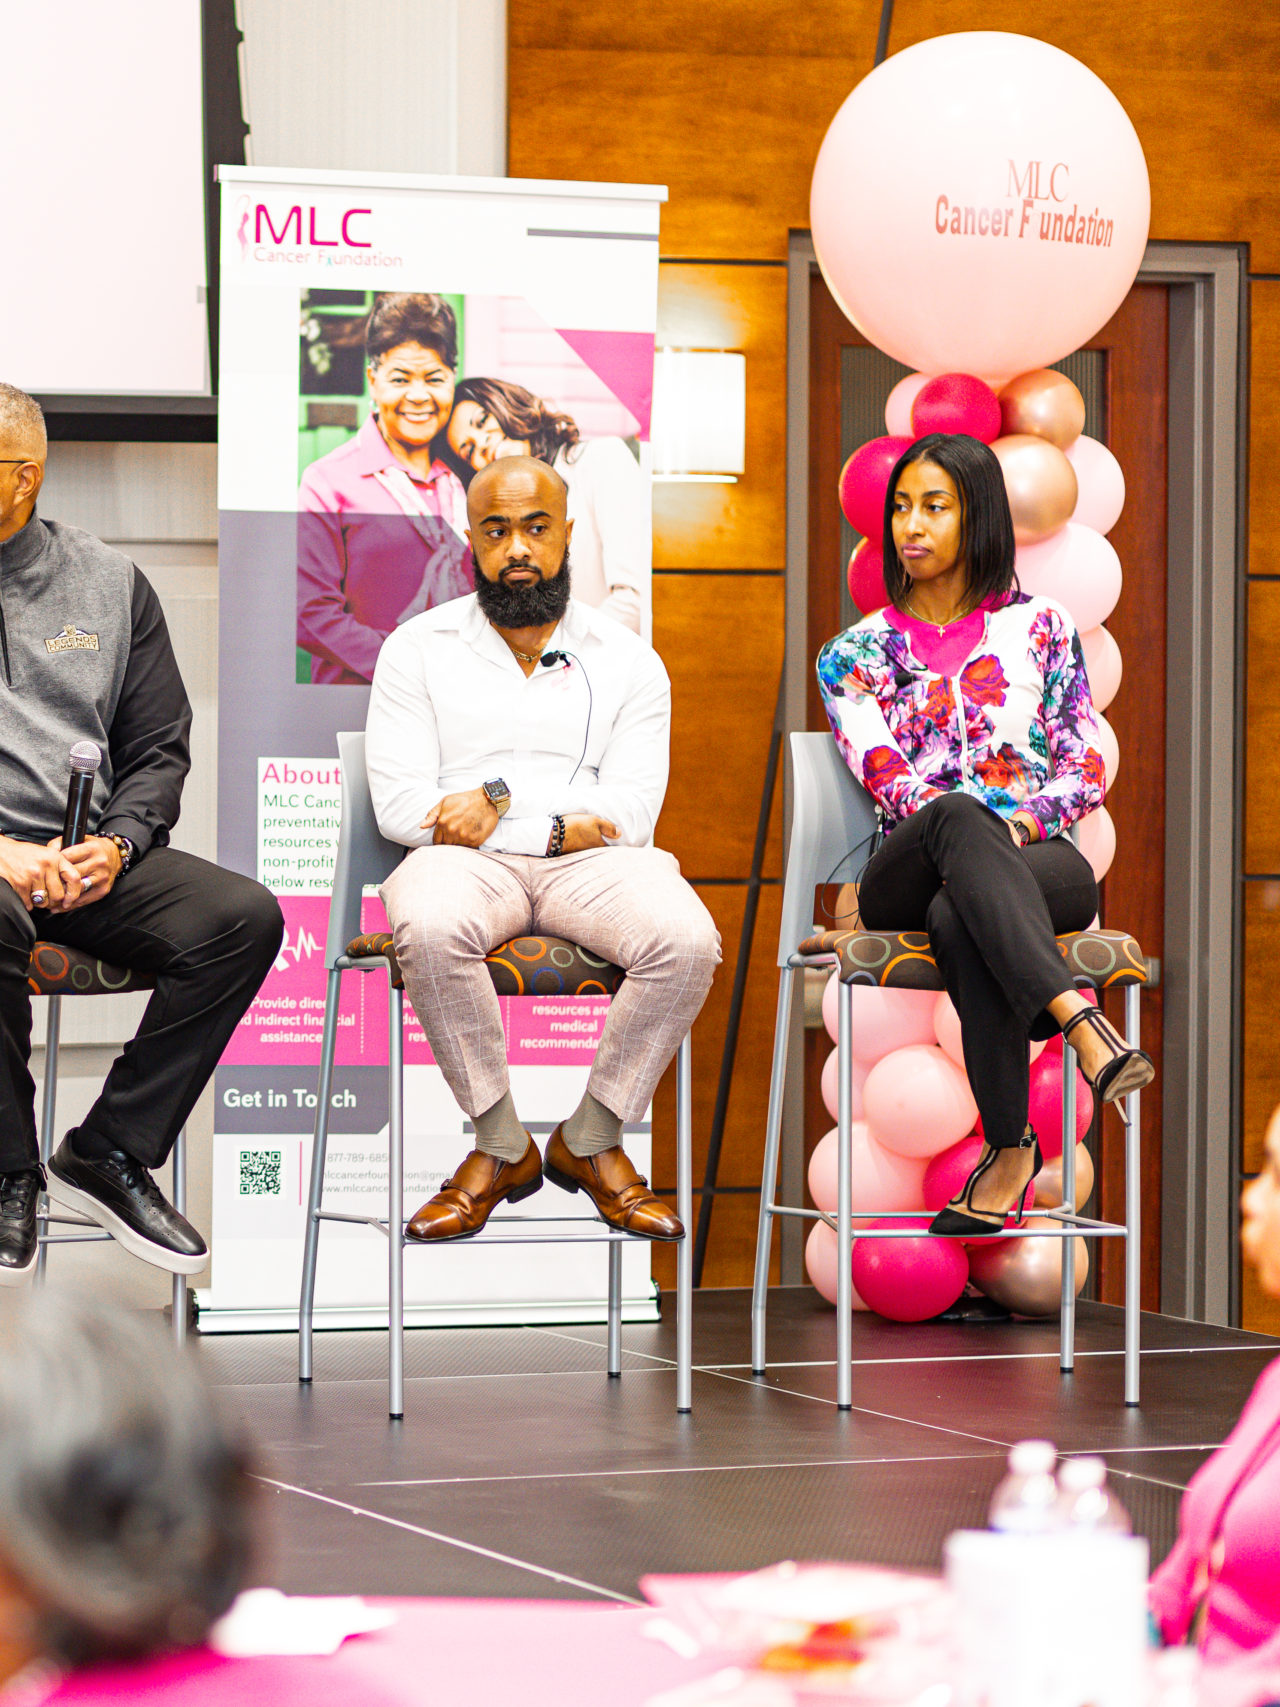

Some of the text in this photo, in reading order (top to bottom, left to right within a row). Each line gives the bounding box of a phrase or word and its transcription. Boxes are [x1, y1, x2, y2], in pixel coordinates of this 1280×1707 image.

[1005, 158, 1070, 203] MLC
[935, 194, 1014, 238] Cancer
[255, 204, 372, 248] MLC
[253, 246, 311, 264] Cancer
[47, 635, 97, 647] LEGENDS
[49, 643, 97, 652] COMMUNITY
[262, 763, 342, 785] About
[263, 794, 341, 809] MLC Canc
[263, 816, 342, 830] preventativ
[263, 837, 332, 849] resources
[263, 855, 334, 870] non-profit
[263, 874, 305, 888] below
[250, 996, 297, 1009] Provide
[532, 1005, 609, 1017] resources an
[254, 1013, 301, 1026] indirect
[550, 1019, 598, 1032] medical
[260, 1031, 324, 1043] assistance
[520, 1036, 600, 1050] recommenda
[223, 1088, 357, 1108] Get in Toch
[327, 1152, 390, 1163] 877-789-685
